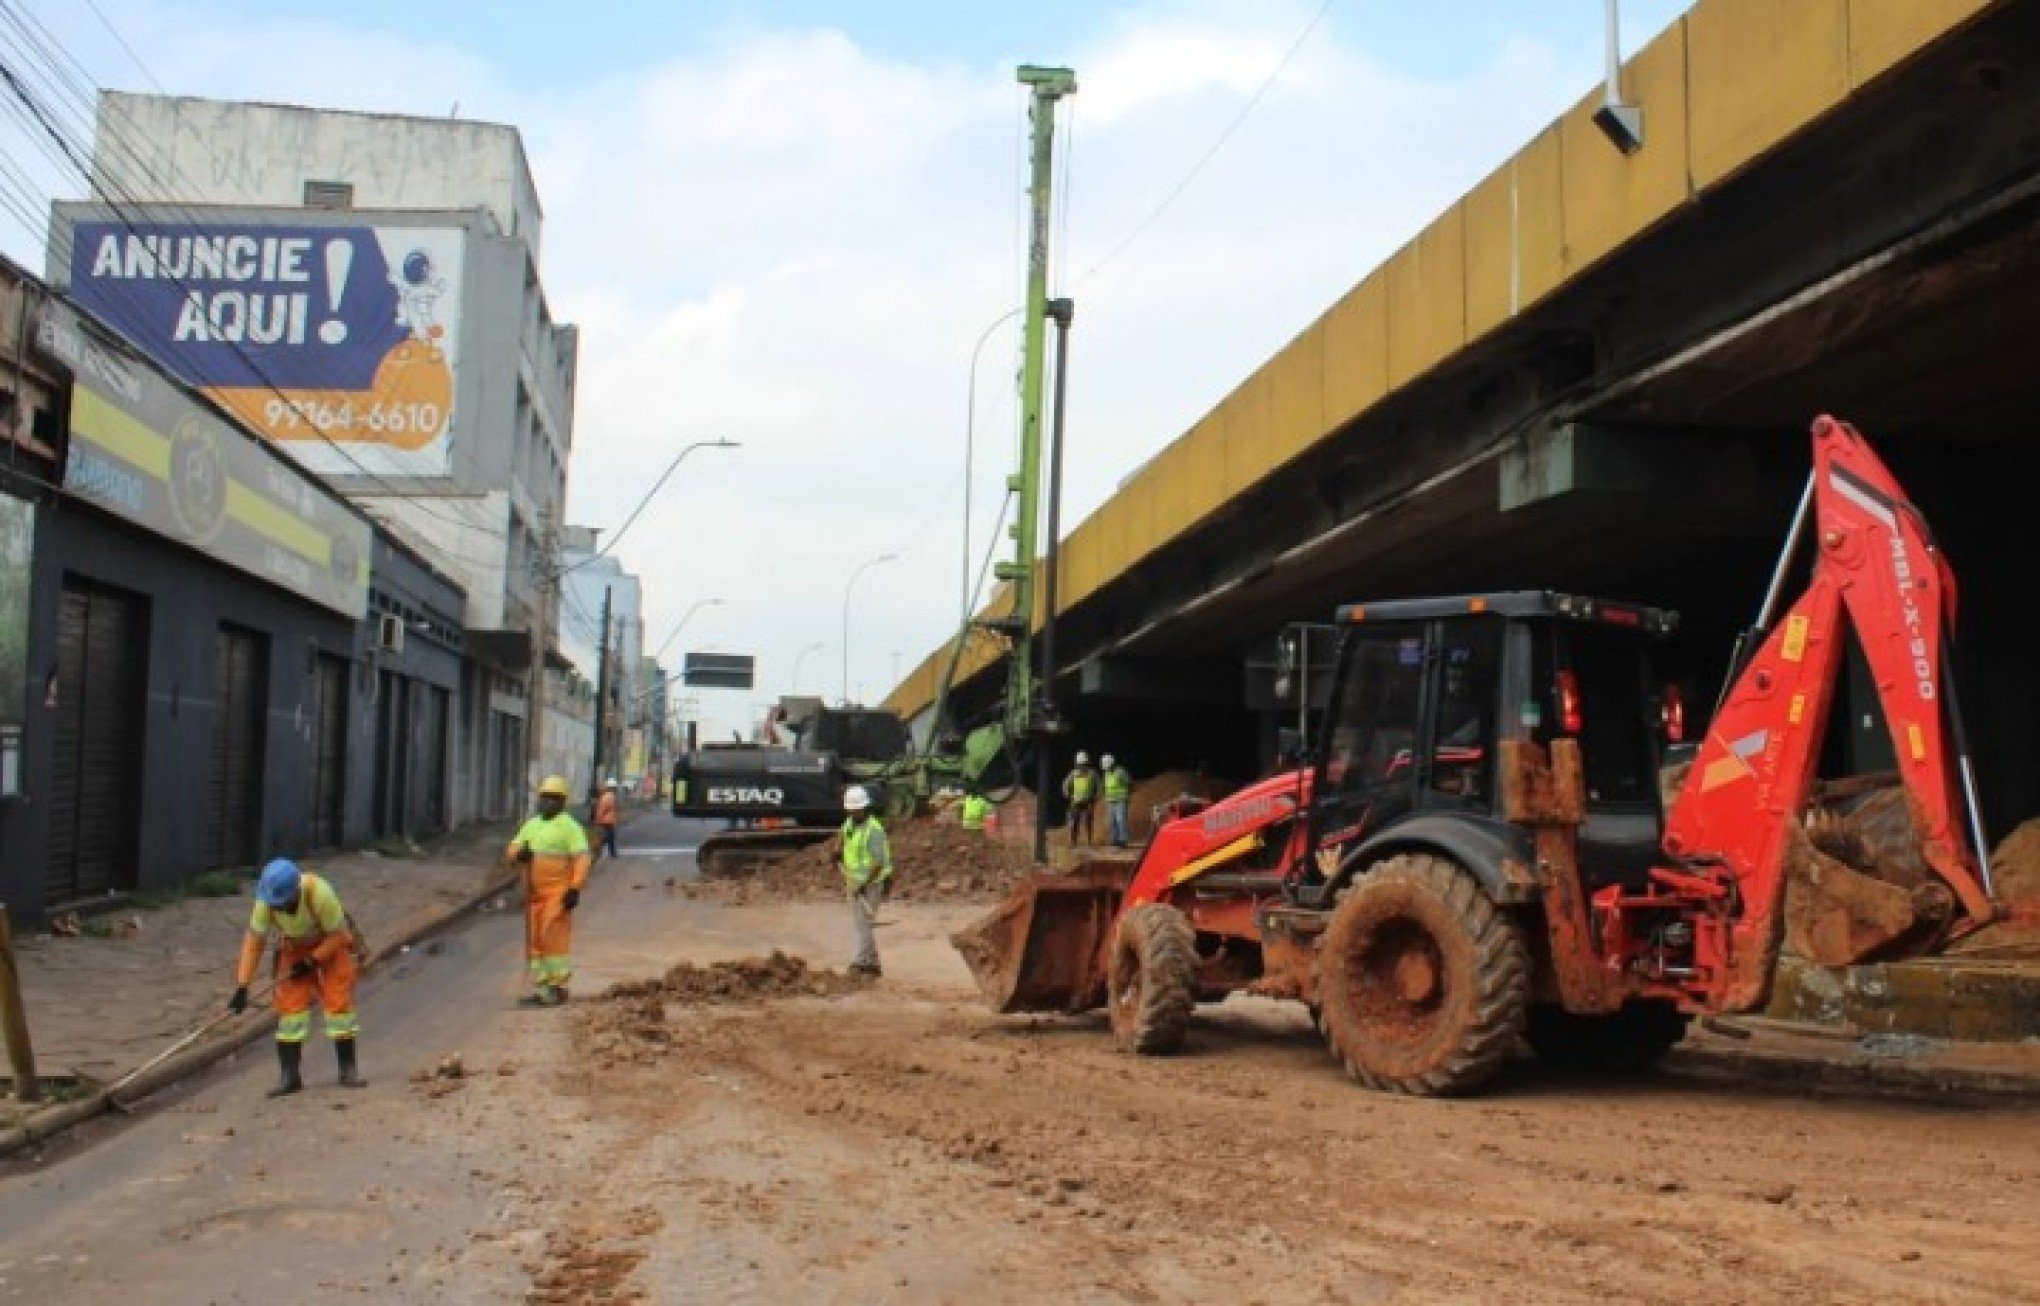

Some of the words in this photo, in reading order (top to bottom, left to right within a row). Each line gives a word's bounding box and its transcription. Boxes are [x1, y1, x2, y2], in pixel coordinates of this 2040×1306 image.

[91, 234, 313, 282] ANUNCIE
[264, 399, 439, 433] 99164-6610
[707, 786, 784, 806] ESTAQ
